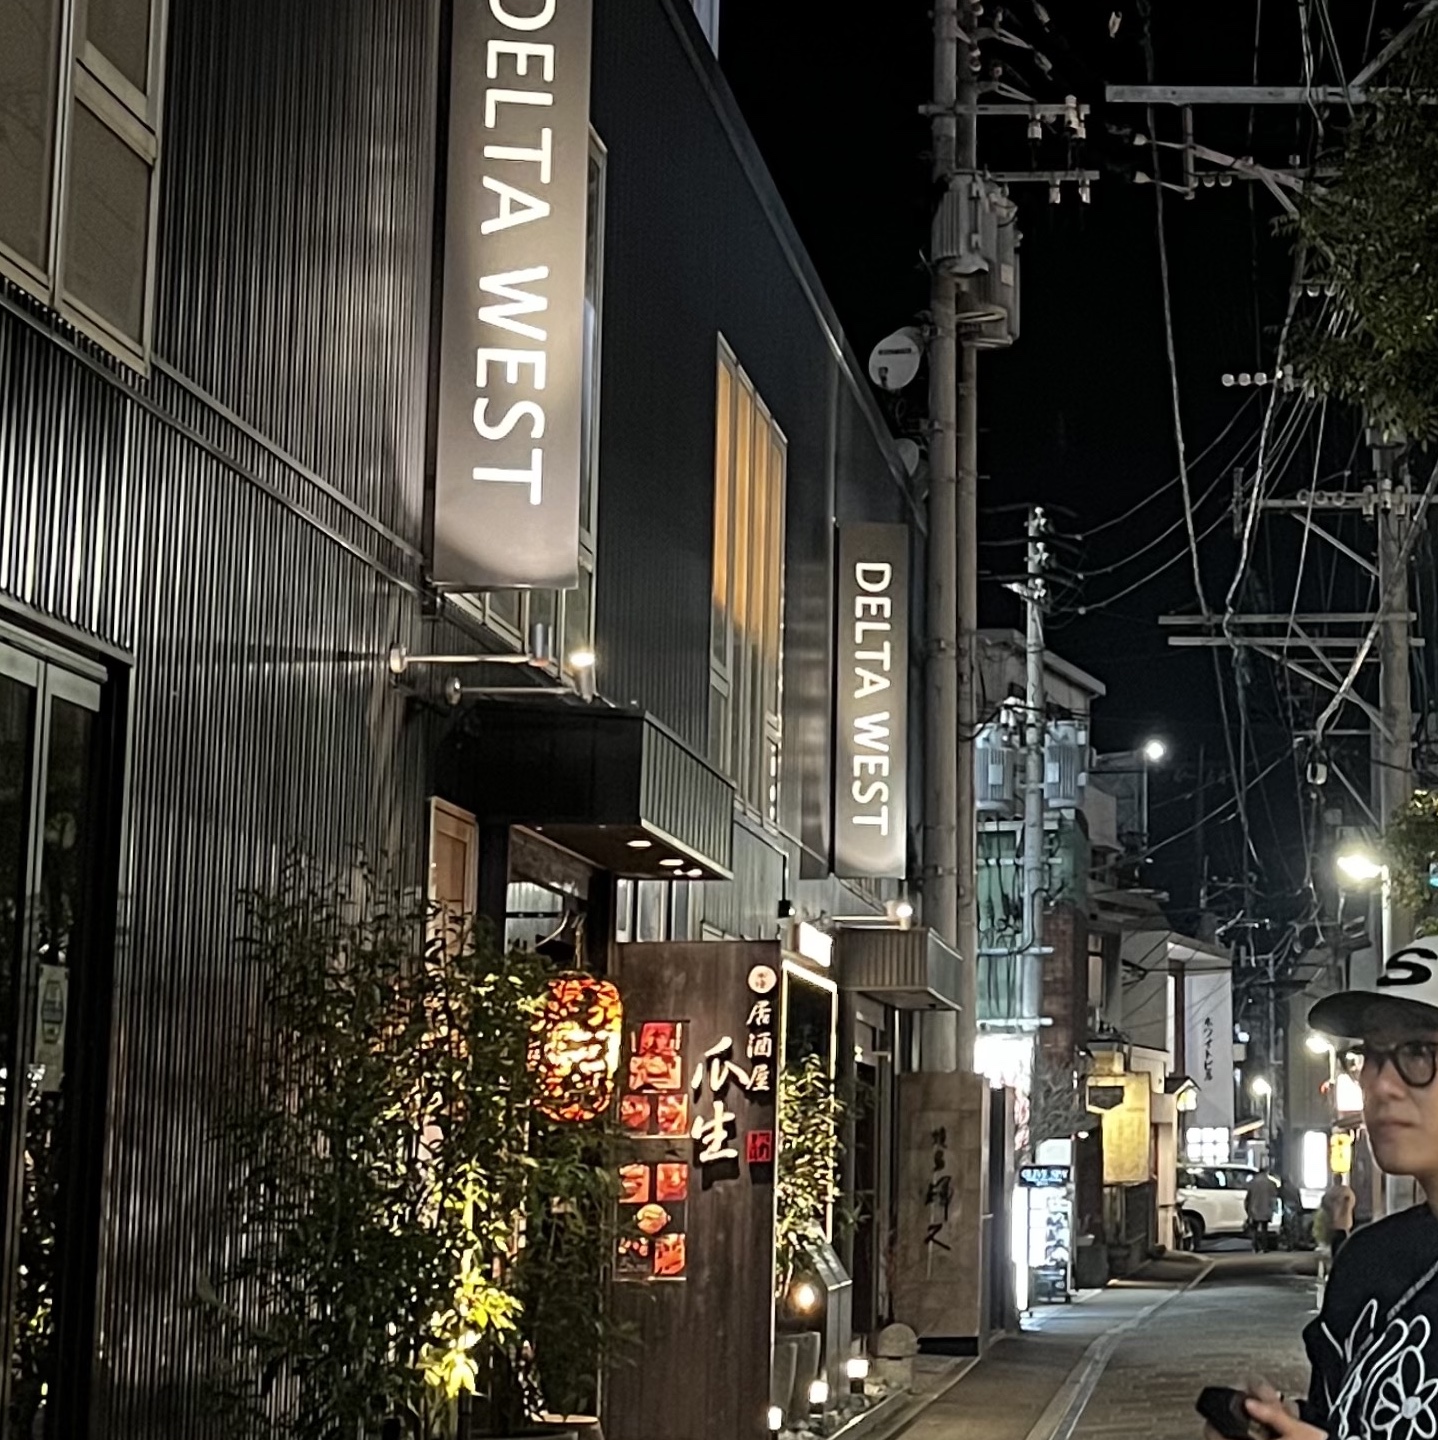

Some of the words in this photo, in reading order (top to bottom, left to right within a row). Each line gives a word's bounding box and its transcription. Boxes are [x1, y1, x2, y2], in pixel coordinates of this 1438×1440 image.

[473, 266, 549, 506] WEST
[854, 562, 892, 700] DELTA
[851, 711, 891, 837] WEST
[1376, 947, 1438, 987] S
[745, 1000, 773, 1092] 居酒屋
